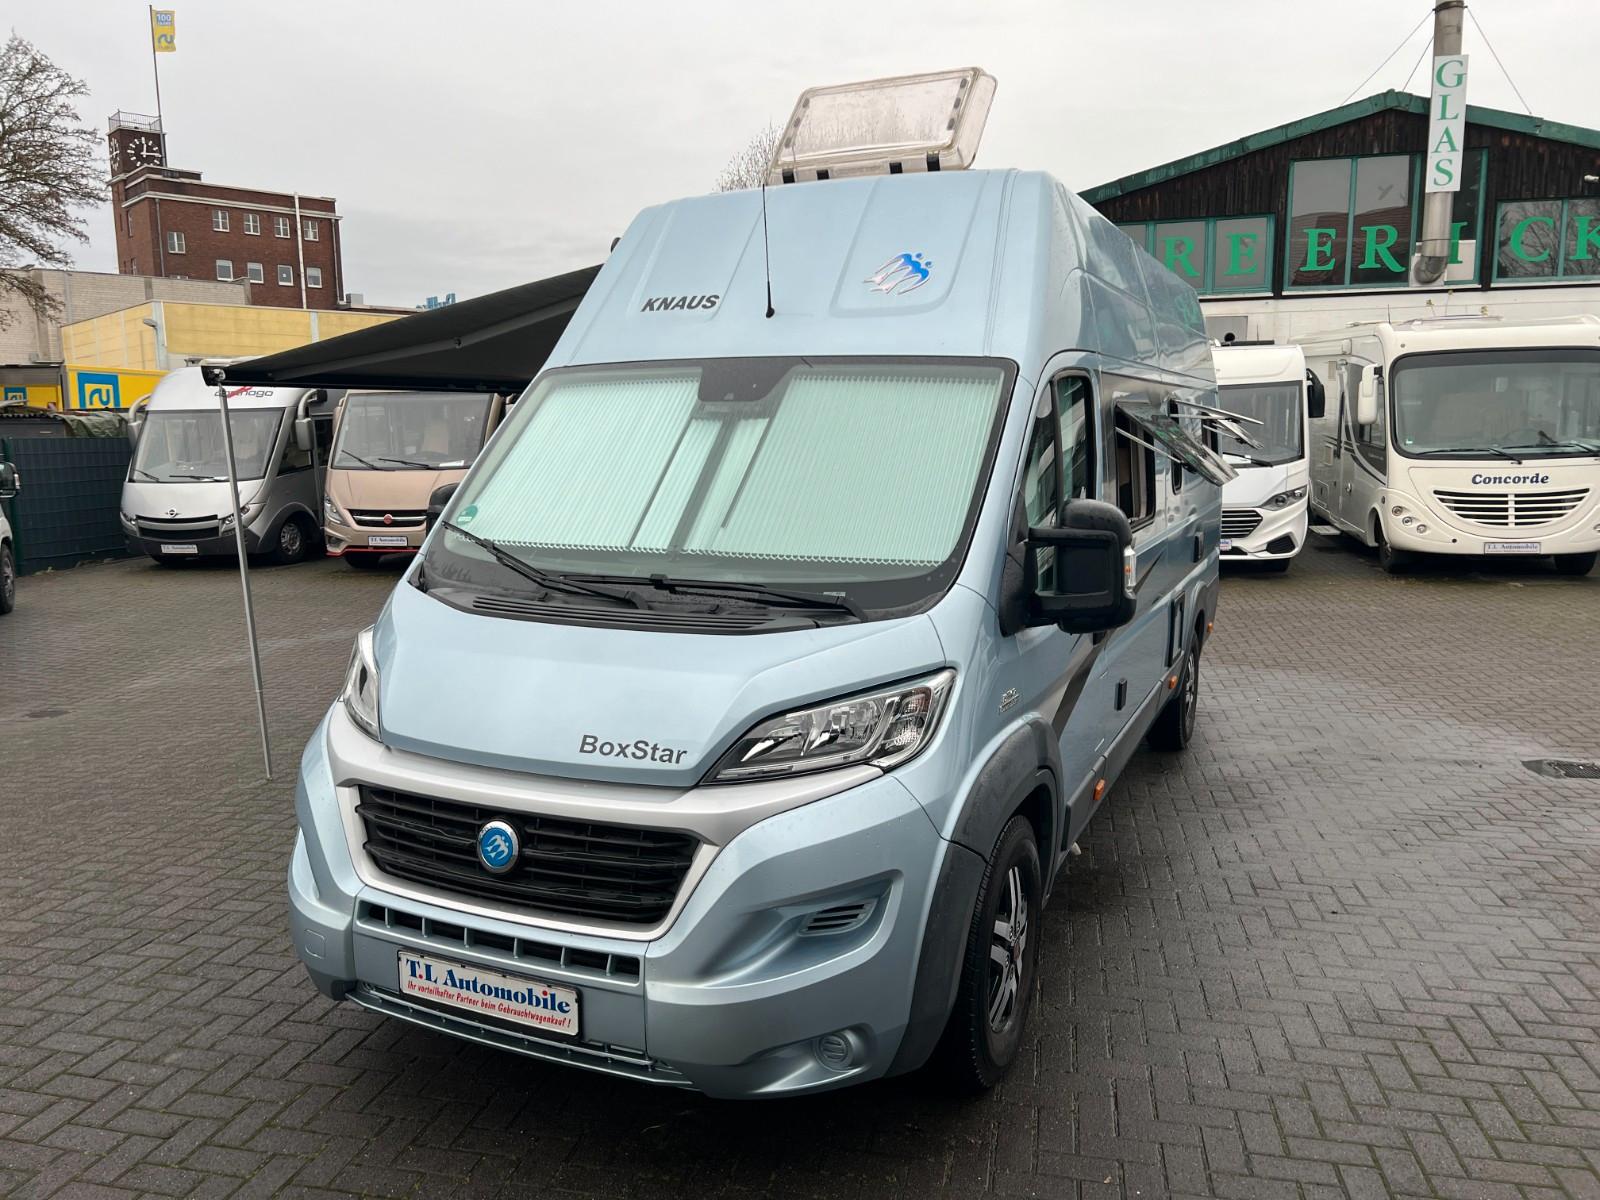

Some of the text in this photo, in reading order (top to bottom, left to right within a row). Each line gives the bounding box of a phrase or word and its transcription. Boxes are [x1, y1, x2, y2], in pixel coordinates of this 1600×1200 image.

[1431, 59, 1468, 187] GLAS
[640, 294, 721, 313] KNAUS
[214, 389, 274, 398] chago
[1471, 472, 1550, 485] Concorde
[579, 734, 688, 765] BoxStar
[406, 958, 572, 1014] T.L Automobile
[407, 980, 417, 991] Ihr
[417, 983, 455, 1001] vorteilhafter
[456, 992, 480, 1007] Partner
[480, 999, 496, 1011] beim
[497, 1002, 567, 1027] Gebrauchtwagenkauf
